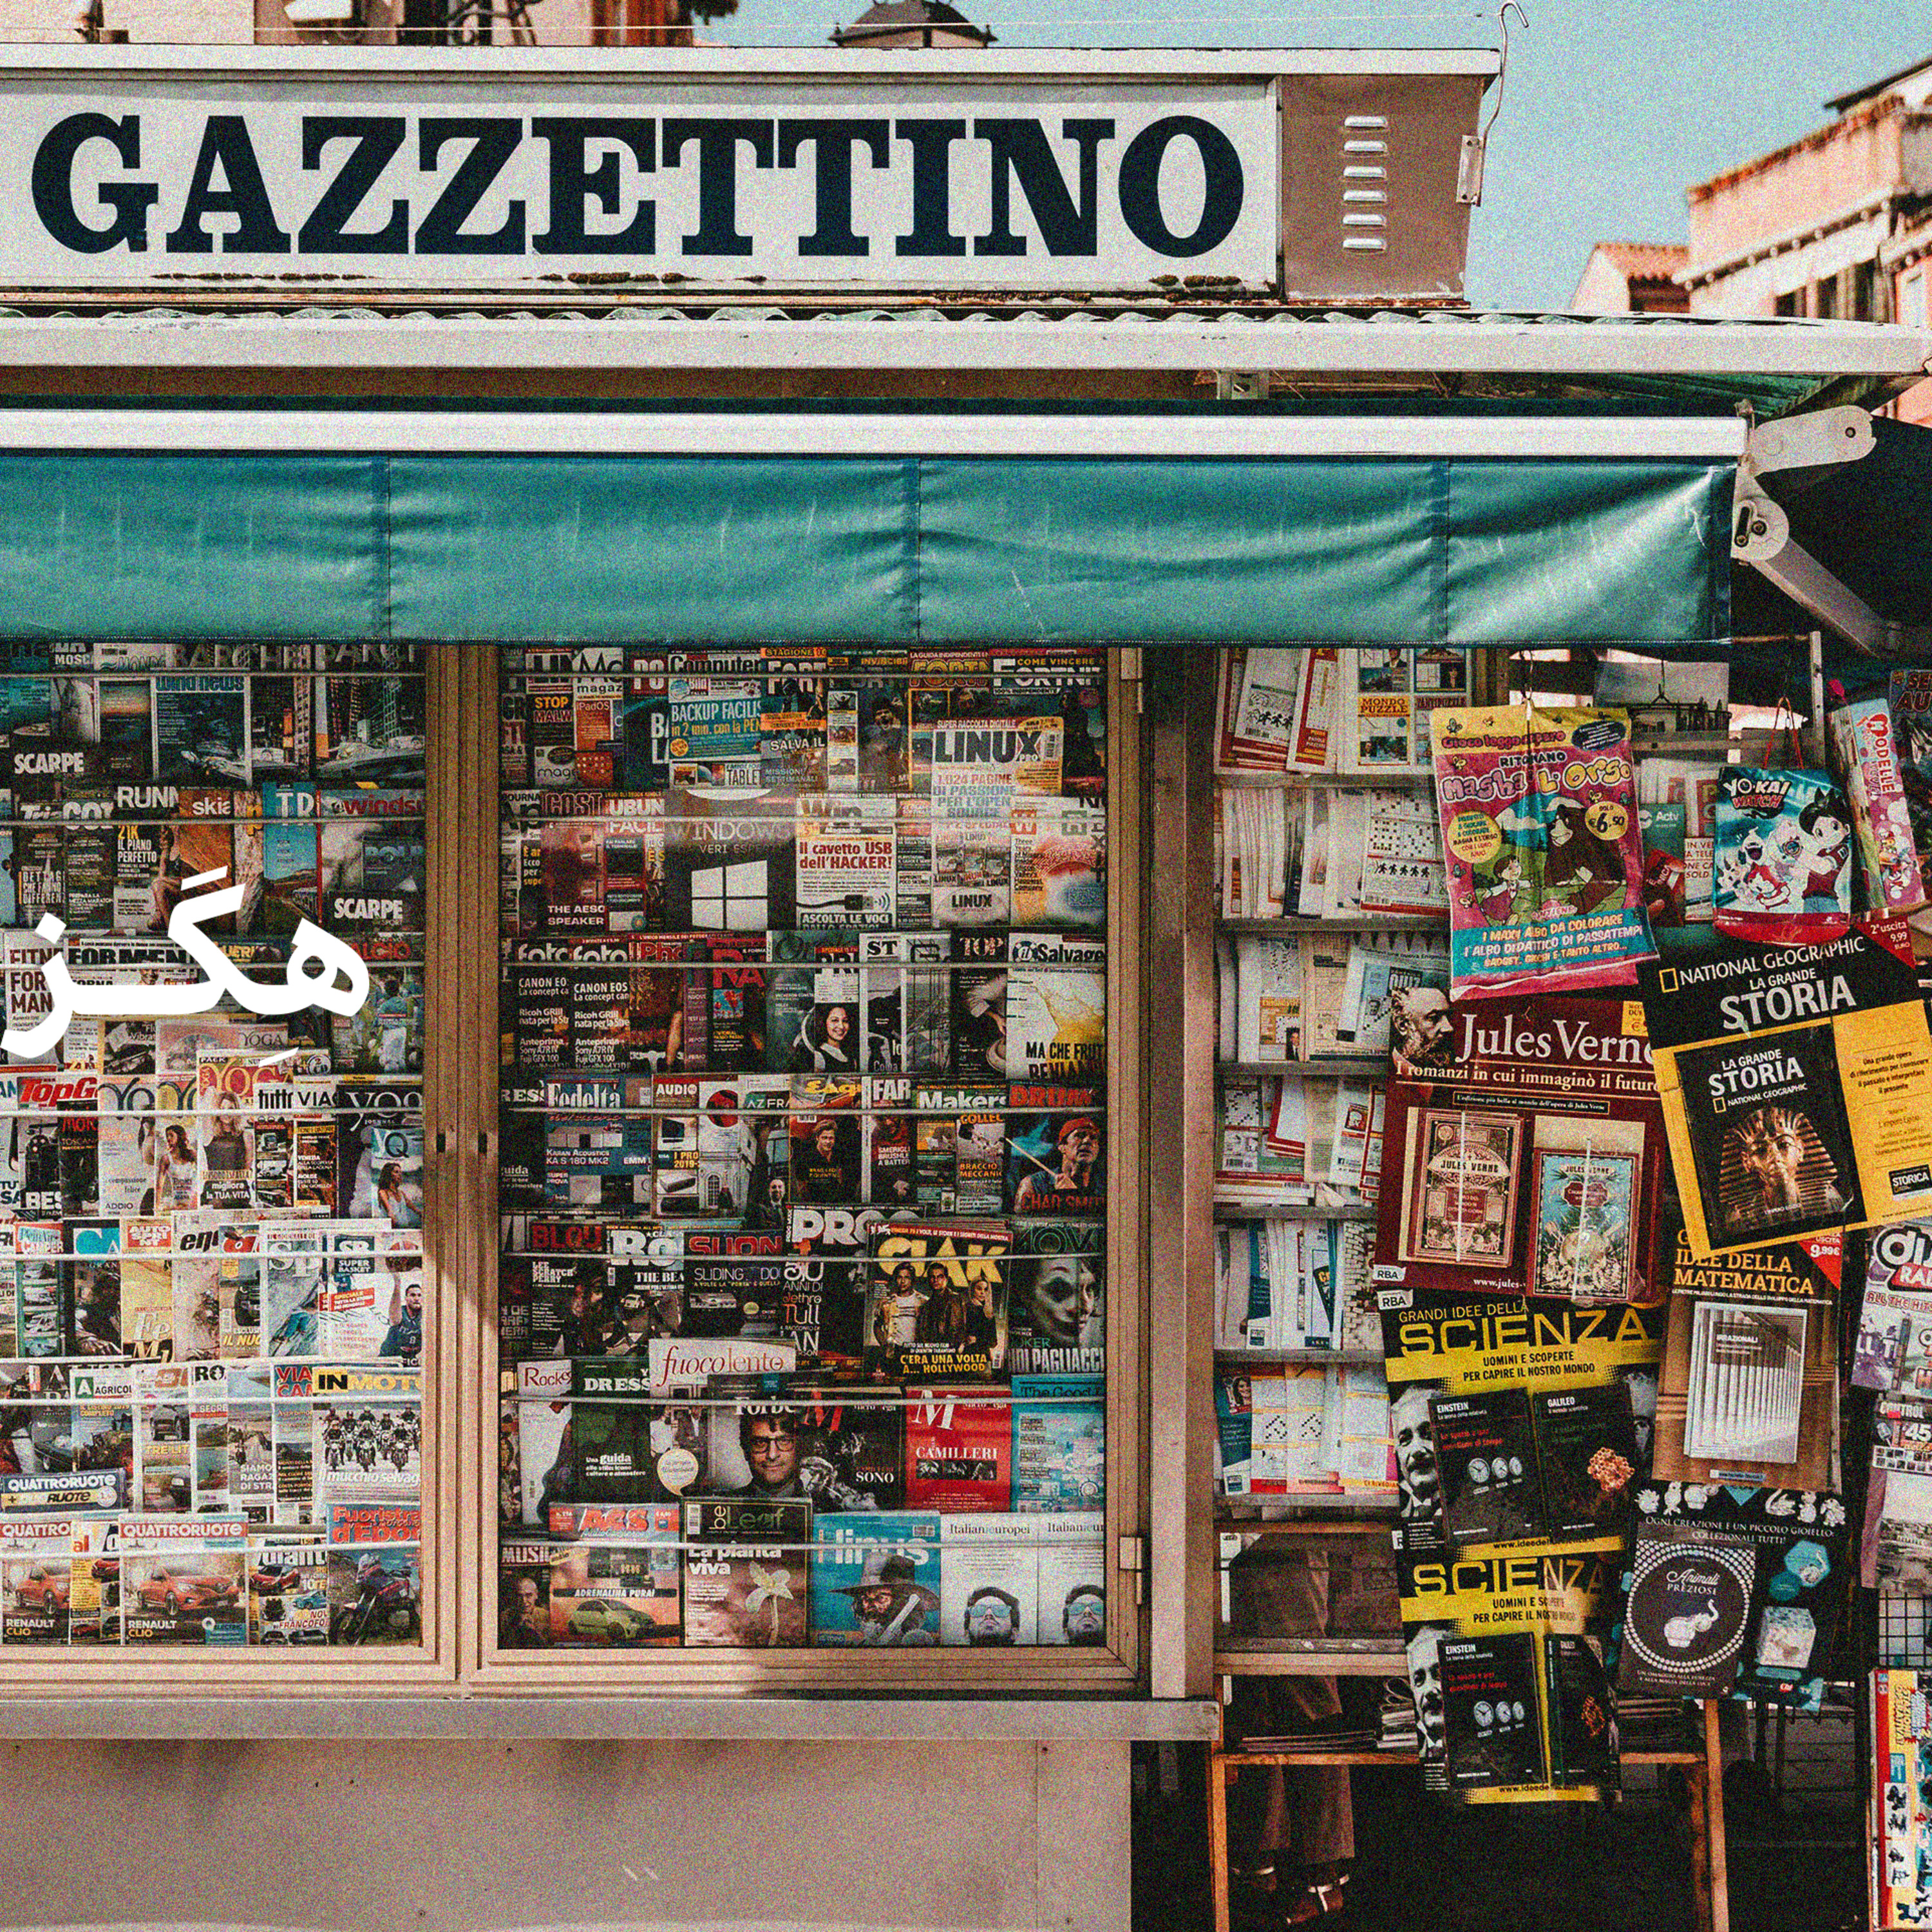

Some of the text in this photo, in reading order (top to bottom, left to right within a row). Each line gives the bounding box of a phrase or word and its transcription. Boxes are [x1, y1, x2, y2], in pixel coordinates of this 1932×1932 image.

[31, 112, 1244, 258] GAZZETTINO
[766, 646, 811, 656] STAGIONE
[1050, 658, 1095, 666] VINCERE
[535, 696, 569, 708] STOP
[1362, 697, 1406, 706] MONDO
[672, 705, 719, 722] BACKUP
[1360, 705, 1408, 714] PUZZLE
[770, 741, 809, 752] SALVA
[934, 730, 1042, 764] LINUX
[14, 752, 84, 773] SCARPE
[1441, 770, 1528, 803] Masha
[1731, 795, 1785, 810] WATCH
[118, 839, 152, 851] IL PIANO
[812, 843, 861, 855] cavetto
[864, 842, 893, 855] USB
[118, 851, 157, 863] PERFETTO
[799, 856, 893, 870] dell'HACKER!
[951, 894, 992, 908] LINUX
[334, 898, 403, 920] SCARPE
[548, 905, 569, 914] THE
[548, 917, 604, 926] SPEAKER
[802, 911, 889, 923] ASCOLTA LE VOCI
[1550, 914, 1624, 934] DA COLORARE
[1880, 921, 1908, 933] uscita
[1504, 938, 1558, 954] DIDATTICO
[1562, 935, 1573, 946] DI
[1577, 925, 1643, 943] PASSATEMPI
[1561, 947, 1589, 958] TANTO
[1679, 936, 1866, 985] NATIONAL GEOGRAPHIC
[10, 972, 46, 992] FOR
[518, 978, 552, 989] CANON
[1748, 968, 1817, 991] LA GRANDE
[529, 988, 559, 998] concept
[574, 981, 629, 994] CANON EOS
[584, 993, 614, 1004] concept
[1719, 974, 1857, 1030] STORIA
[574, 1011, 596, 1020] Ricoh
[239, 1032, 286, 1046] YOGA
[1455, 1013, 1551, 1064] Jules
[1025, 1041, 1045, 1059] MA
[1049, 1041, 1070, 1060] CHE
[1721, 1048, 1783, 1071] LA GRANDE
[1406, 1064, 1468, 1081] romanzi
[1473, 1065, 1488, 1081] in
[1492, 1068, 1516, 1083] cui
[1520, 1071, 1596, 1091] immaginò
[1600, 1073, 1611, 1088] il
[1708, 1056, 1804, 1097] STORIA
[1728, 1083, 1808, 1107] NATIONAL GEOGRAPHIC
[590, 1157, 609, 1166] MK2
[1470, 1161, 1499, 1174] VERNE
[1892, 1171, 1929, 1187] STORICA
[1726, 1252, 1793, 1273] DELLA
[634, 1271, 660, 1283] THE
[1377, 1269, 1399, 1280] RBA
[1674, 1268, 1815, 1296] MATEMATICA
[1381, 1295, 1406, 1307] RBA
[1398, 1300, 1530, 1323] GRANDI IDEE DELLA
[1398, 1309, 1650, 1358] SCIENZA
[900, 1354, 987, 1365] C'ERA UNA VOLTA
[1032, 1347, 1105, 1374] PAGLIACCI
[1482, 1350, 1575, 1367] UOMINI E SCOPERTE
[923, 1363, 986, 1373] HOLLYWOOD
[1463, 1362, 1596, 1383] PER CAPIRE IL NOSTRO MONDO
[318, 1374, 348, 1390] IN
[1436, 1401, 1470, 1414] EINSTEIN
[1547, 1396, 1576, 1408] GALILEO
[600, 1454, 632, 1465] guida
[915, 1446, 998, 1460] CAMILLERI
[856, 1471, 895, 1483] SONO
[1645, 1515, 1671, 1526] OGNI
[1674, 1517, 1723, 1530] CREAZIONE
[1748, 1523, 1788, 1535] PICCOLO
[688, 1558, 731, 1575] viva
[1665, 1567, 1721, 1587] Animali
[574, 1589, 627, 1598] ADRENALINA
[1666, 1583, 1718, 1596] PREZIOSI
[1492, 1597, 1528, 1609] UOMINI
[6, 1618, 55, 1628] RENAULT
[1473, 1610, 1534, 1624] PER CAPIRE IL
[129, 1620, 177, 1629] RENAULT
[6, 1627, 31, 1636] CLIO
[129, 1629, 153, 1638] CLIO
[1444, 1643, 1477, 1655] EINSTEIN
